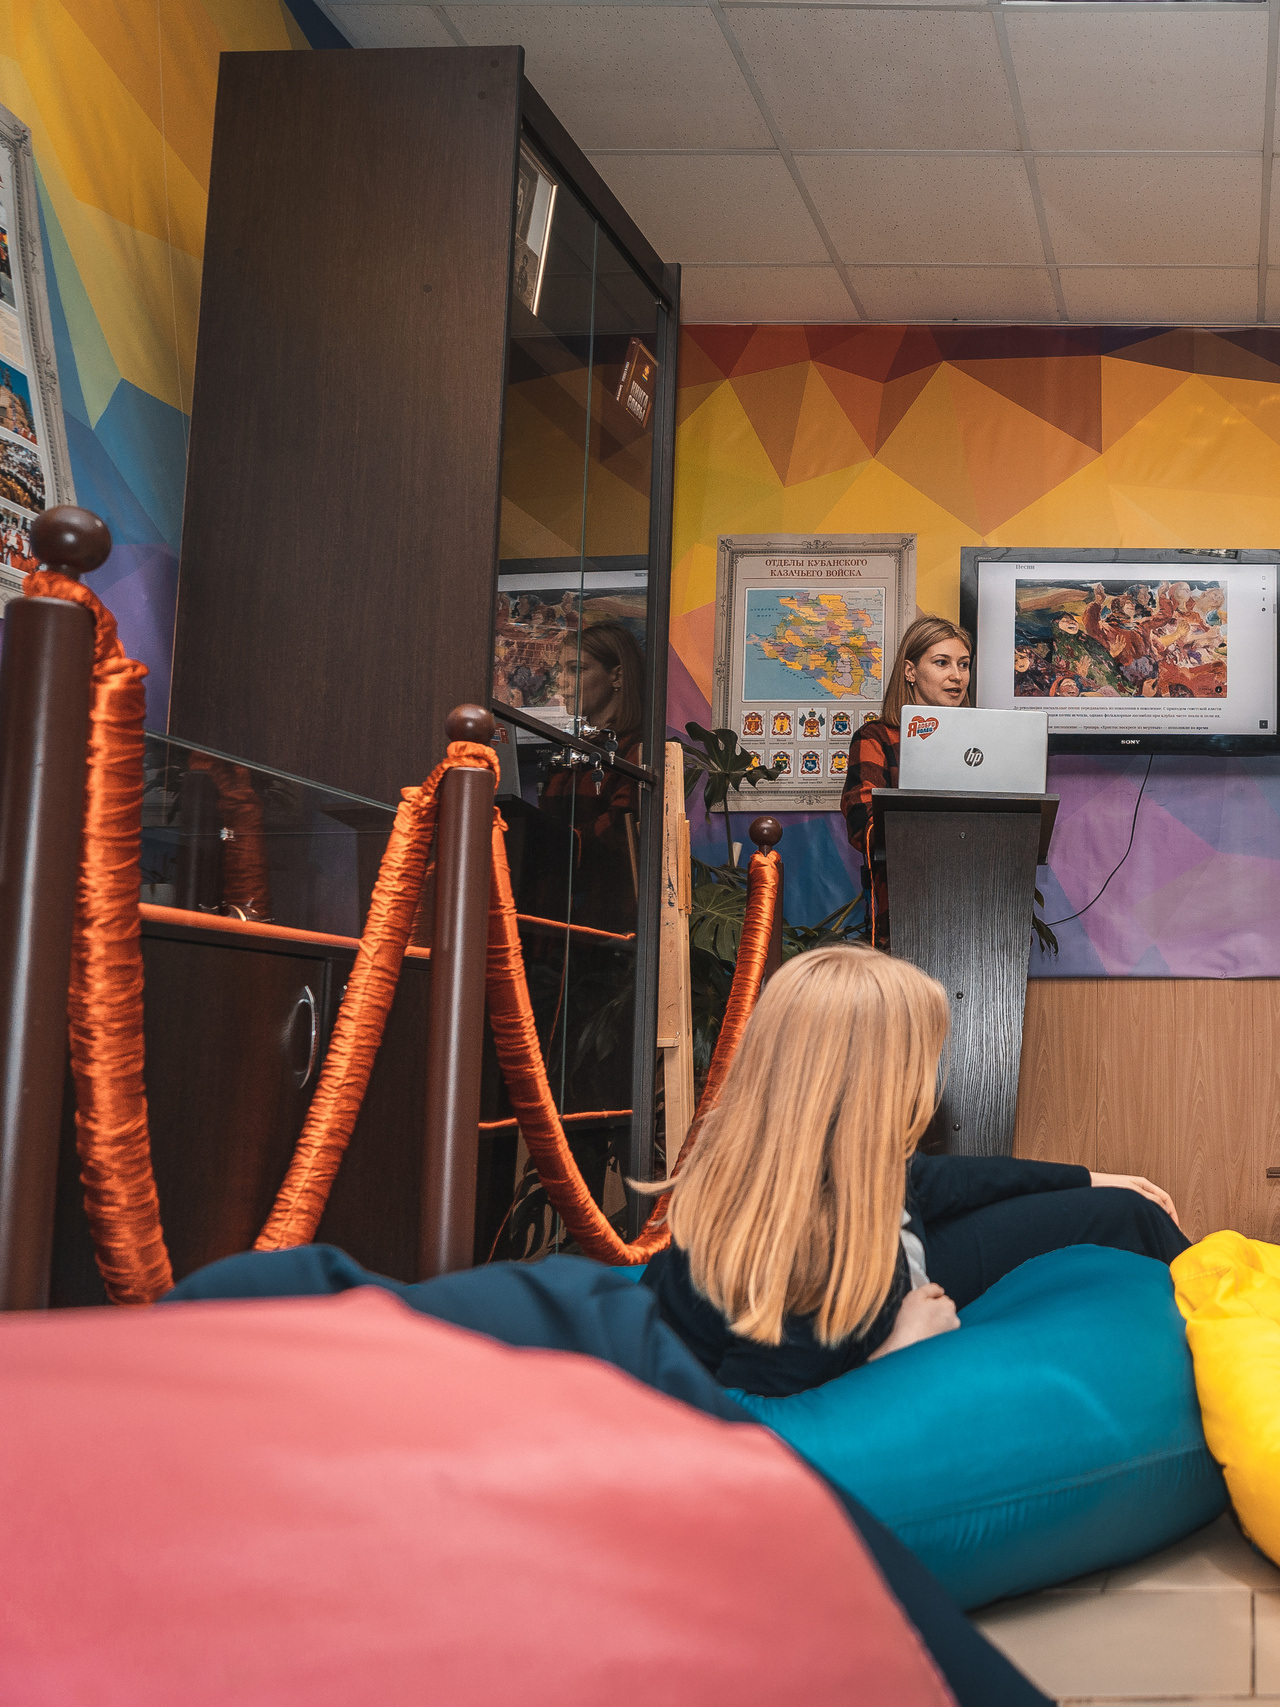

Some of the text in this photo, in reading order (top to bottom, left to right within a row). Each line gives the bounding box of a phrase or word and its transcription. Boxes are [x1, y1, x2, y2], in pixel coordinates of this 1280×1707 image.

[765, 559, 868, 568] ОТДЕЛЫ КУБАНСКОГО
[770, 568, 862, 578] КАЗАЧЬЕГО ВОЙСКА
[907, 722, 917, 737] Я
[964, 747, 984, 768] hp
